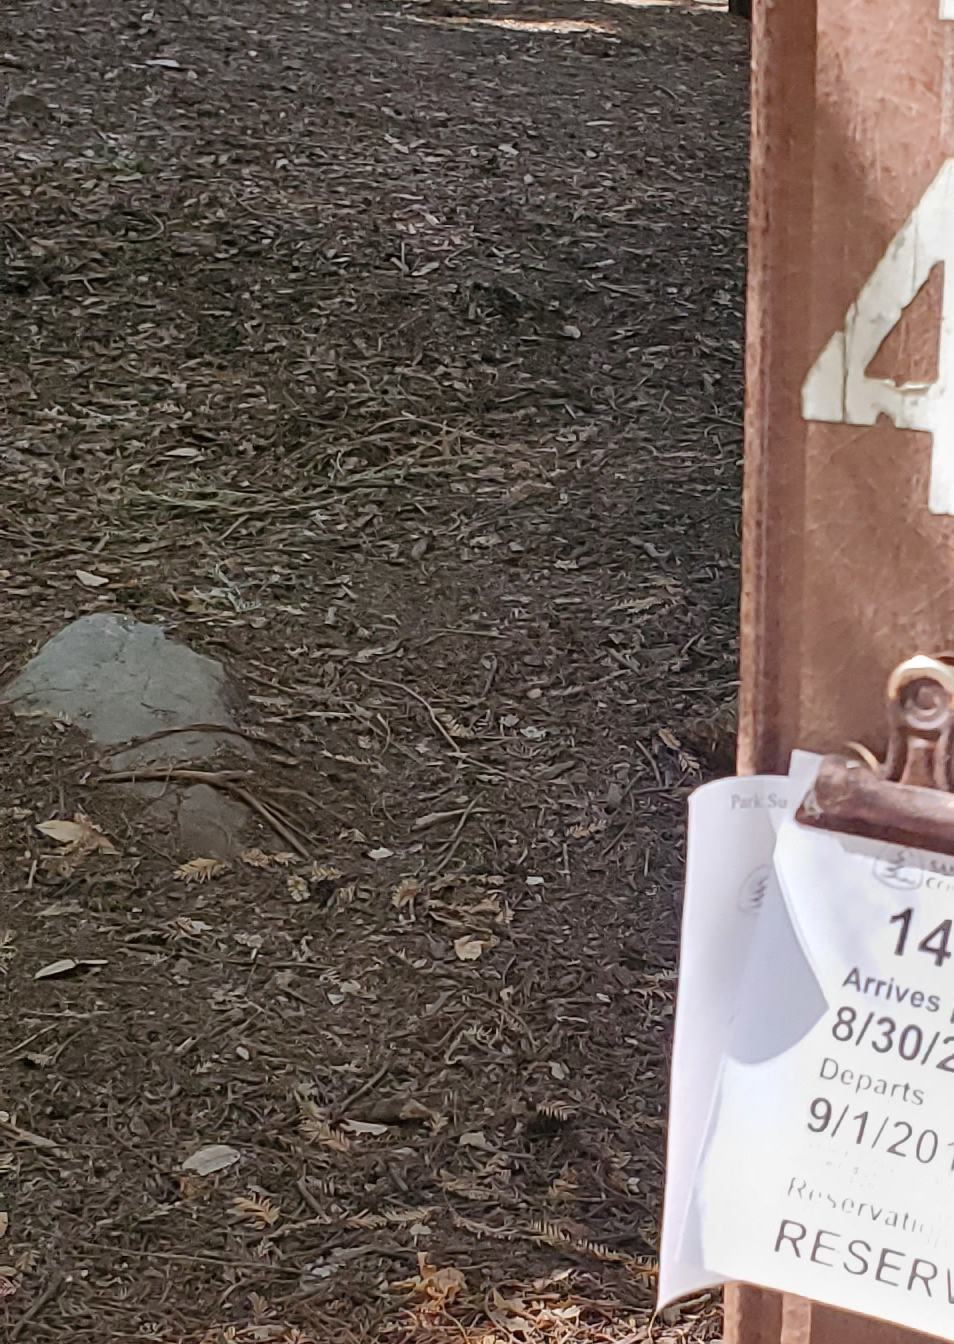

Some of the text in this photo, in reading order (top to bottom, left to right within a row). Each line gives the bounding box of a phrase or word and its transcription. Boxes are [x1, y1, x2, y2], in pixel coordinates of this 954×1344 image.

[731, 793, 763, 809] Park
[889, 906, 953, 967] 14
[842, 967, 941, 1013] Arrives
[818, 1057, 926, 1107] Departs
